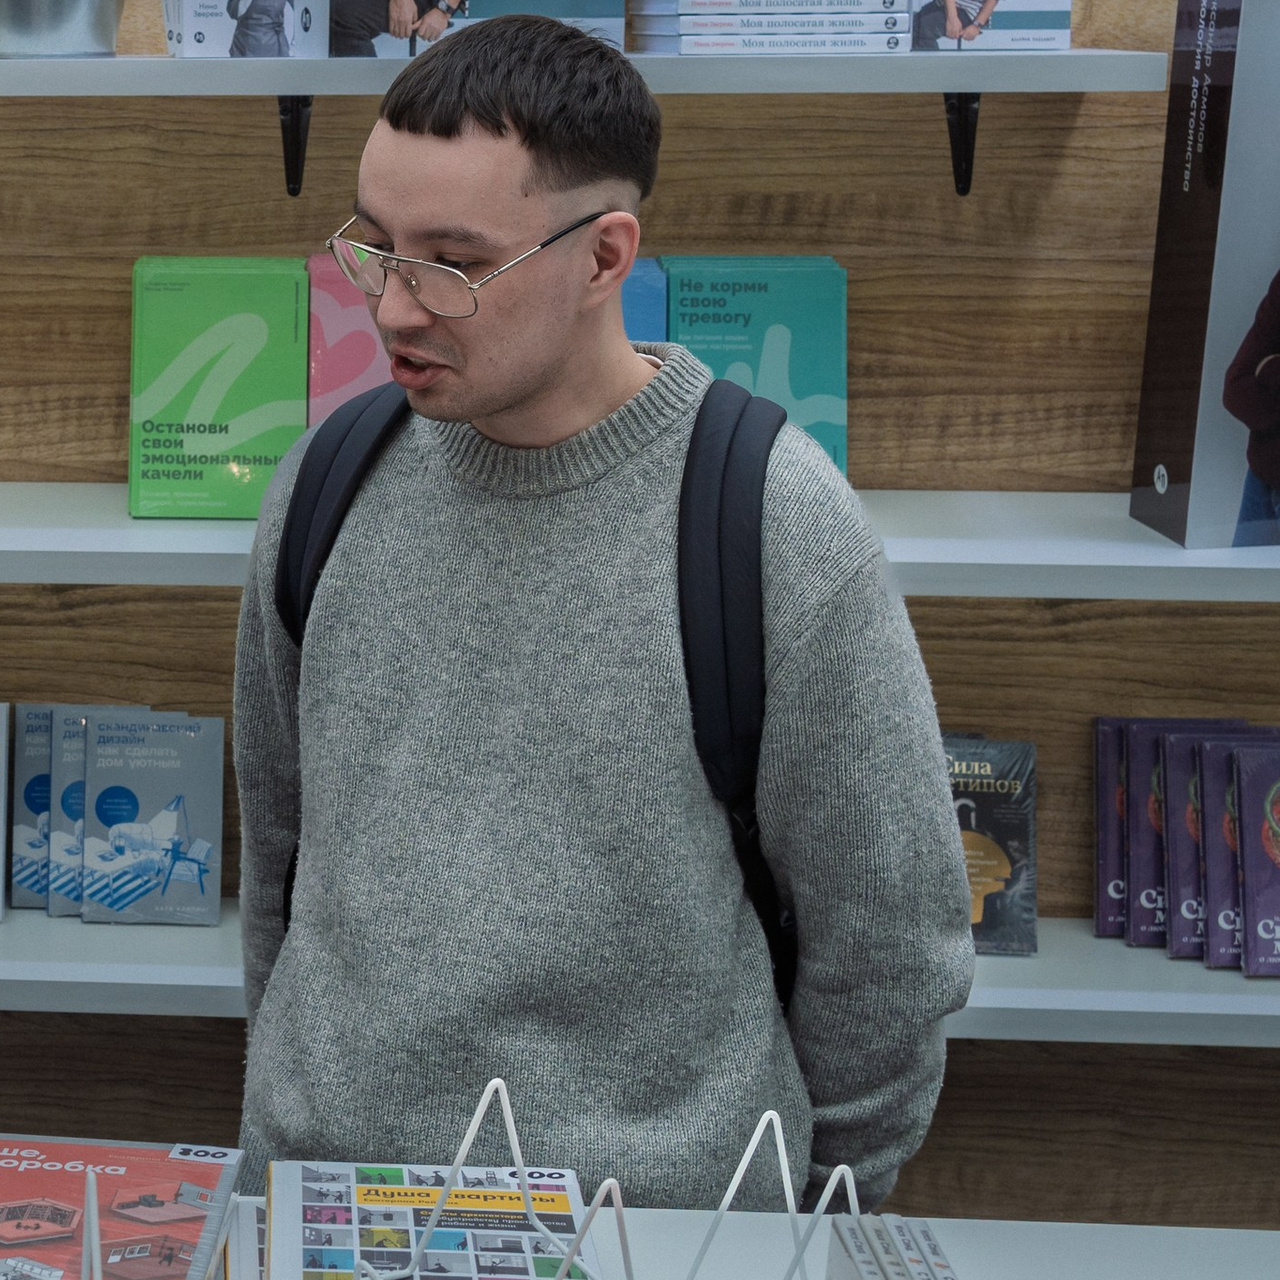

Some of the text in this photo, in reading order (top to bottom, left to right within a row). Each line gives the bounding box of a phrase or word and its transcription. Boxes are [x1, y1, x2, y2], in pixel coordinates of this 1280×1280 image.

[1196, 73, 1212, 153] Асмолов
[1183, 76, 1199, 192] достоинства
[679, 279, 768, 296] Не корми
[679, 297, 727, 308] свою
[679, 312, 752, 327] тревогу
[141, 420, 229, 434] Останови
[141, 438, 184, 449] свои
[141, 469, 204, 481] качели
[97, 722, 201, 734] скандинавский
[97, 734, 145, 745] дизайн
[97, 746, 178, 758] как сделать
[97, 758, 181, 770] дом уютным
[946, 754, 992, 775] Сила
